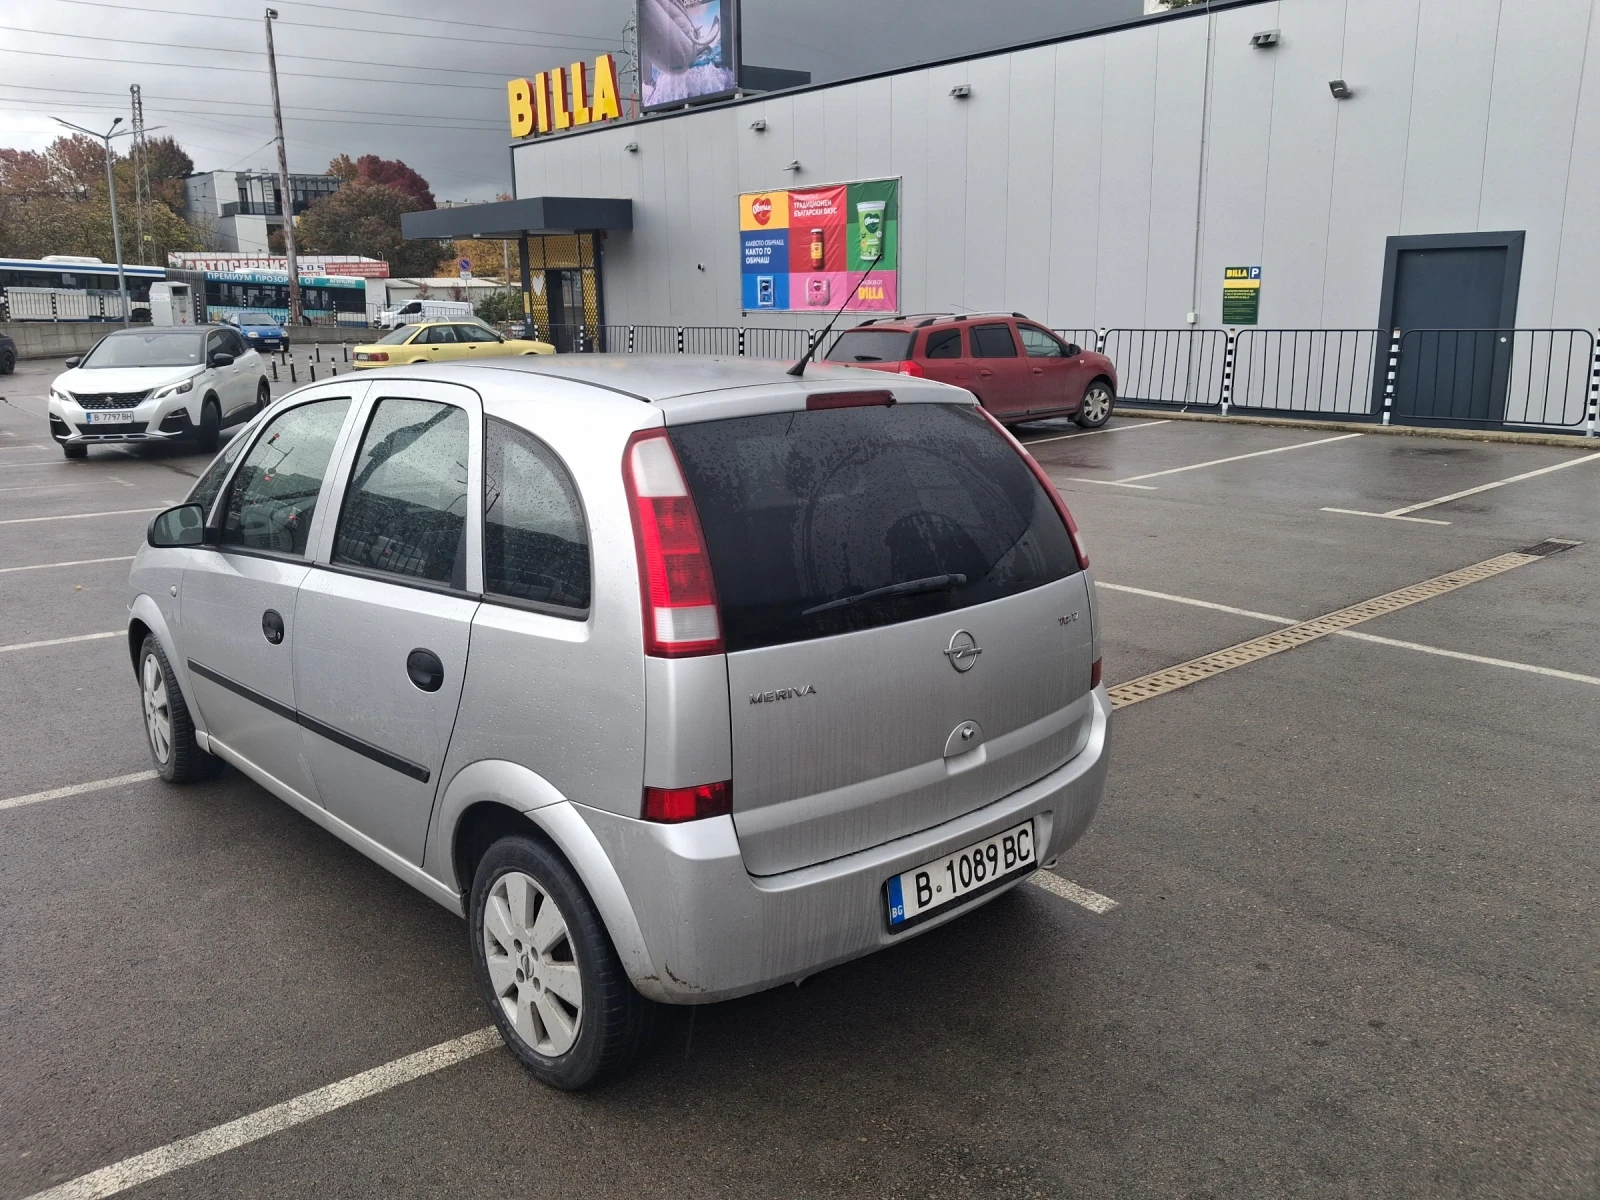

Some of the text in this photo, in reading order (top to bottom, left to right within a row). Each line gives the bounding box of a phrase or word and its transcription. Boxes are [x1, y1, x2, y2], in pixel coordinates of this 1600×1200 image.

[508, 54, 622, 138] BILLA
[793, 200, 832, 208] ТРАДИЦИОНЕН
[793, 207, 838, 217] БЪЛГАРСКИ ВКУС
[745, 247, 772, 256] КАКТО ГО
[745, 256, 770, 264] ОБИЧАШ
[207, 272, 315, 285] ПРЕМИУМ ПРОЗОР ОТ
[1226, 268, 1259, 278] BILLA P
[858, 286, 884, 300] BILLA
[102, 413, 120, 421] 7797
[121, 413, 132, 421] BH
[749, 685, 817, 705] MERIVA
[915, 829, 1030, 909] B 1089 BC
[892, 905, 903, 918] BG
